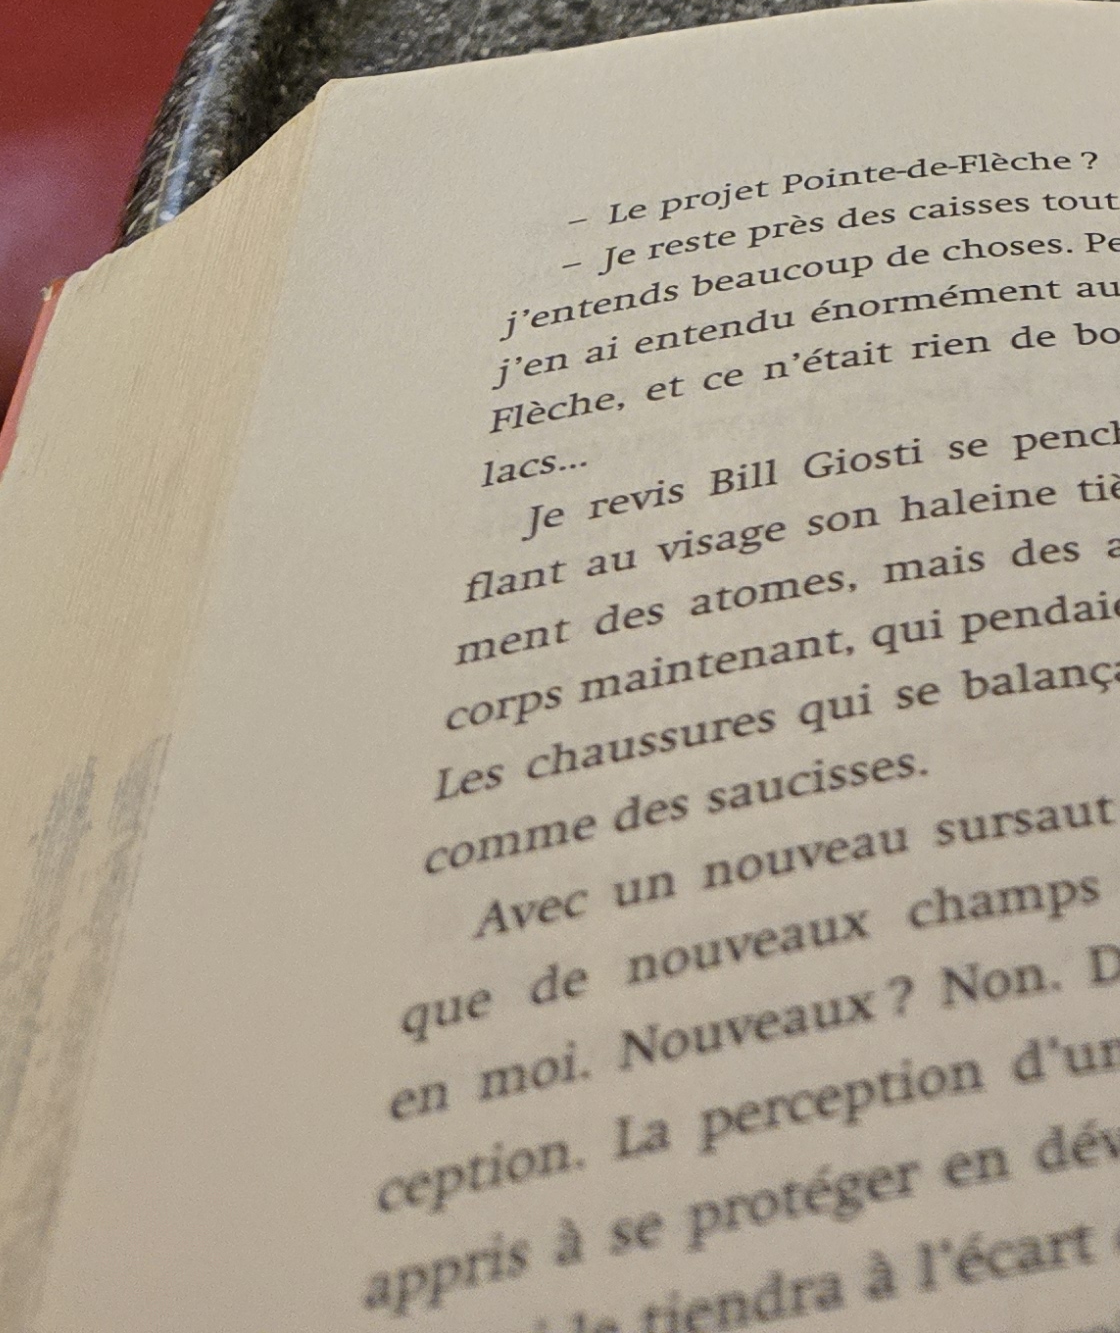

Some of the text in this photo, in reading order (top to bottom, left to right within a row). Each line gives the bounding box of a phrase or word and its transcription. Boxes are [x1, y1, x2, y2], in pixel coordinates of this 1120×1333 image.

[599, 247, 635, 275] Je
[649, 231, 735, 259] reste
[749, 215, 823, 247] près
[838, 208, 895, 228] des
[909, 197, 1029, 220] caisses
[610, 152, 1070, 224] Le projet Pointe-de-Flèche
[586, 337, 616, 363] ai
[635, 310, 793, 353] entendu
[811, 281, 1059, 322] énormément
[1077, 282, 1120, 297] au
[693, 256, 873, 296] beaucoup
[887, 245, 929, 267] de
[943, 239, 1072, 260] choses.
[491, 393, 624, 433] Flèche,
[647, 378, 682, 400] et
[704, 369, 743, 390] ce
[913, 334, 990, 359] rien
[1011, 326, 1055, 349] de
[466, 562, 565, 602] flant
[587, 550, 635, 576] au
[658, 523, 785, 561] visage
[808, 508, 878, 535] son
[902, 484, 1055, 521] haleine
[522, 506, 564, 541] Je
[590, 481, 683, 519] revis
[711, 460, 776, 495] Bill
[804, 439, 922, 478] Giosti
[949, 439, 987, 459] se
[457, 620, 568, 664] ment
[595, 604, 663, 635] des
[691, 571, 856, 616] atomes,
[885, 547, 984, 583] mais
[1011, 539, 1079, 566] des
[446, 687, 561, 730] corps
[581, 630, 853, 702] maintenant,
[872, 610, 942, 654] qui
[436, 765, 503, 800] Les
[527, 710, 775, 779] chaussures
[799, 684, 871, 733] qui
[897, 684, 939, 709] se
[425, 755, 927, 874] comme des saucisses.
[475, 891, 587, 937] Avec
[615, 873, 674, 907] un
[704, 828, 907, 889] nouveau
[937, 797, 1113, 846] sursaut
[402, 990, 491, 1042] que
[531, 965, 587, 1005] de
[628, 912, 868, 984] nouveaux
[908, 878, 1099, 928] champs
[481, 965, 1059, 1100] moi. Nouveaux Non.
[701, 1060, 984, 1154] perception
